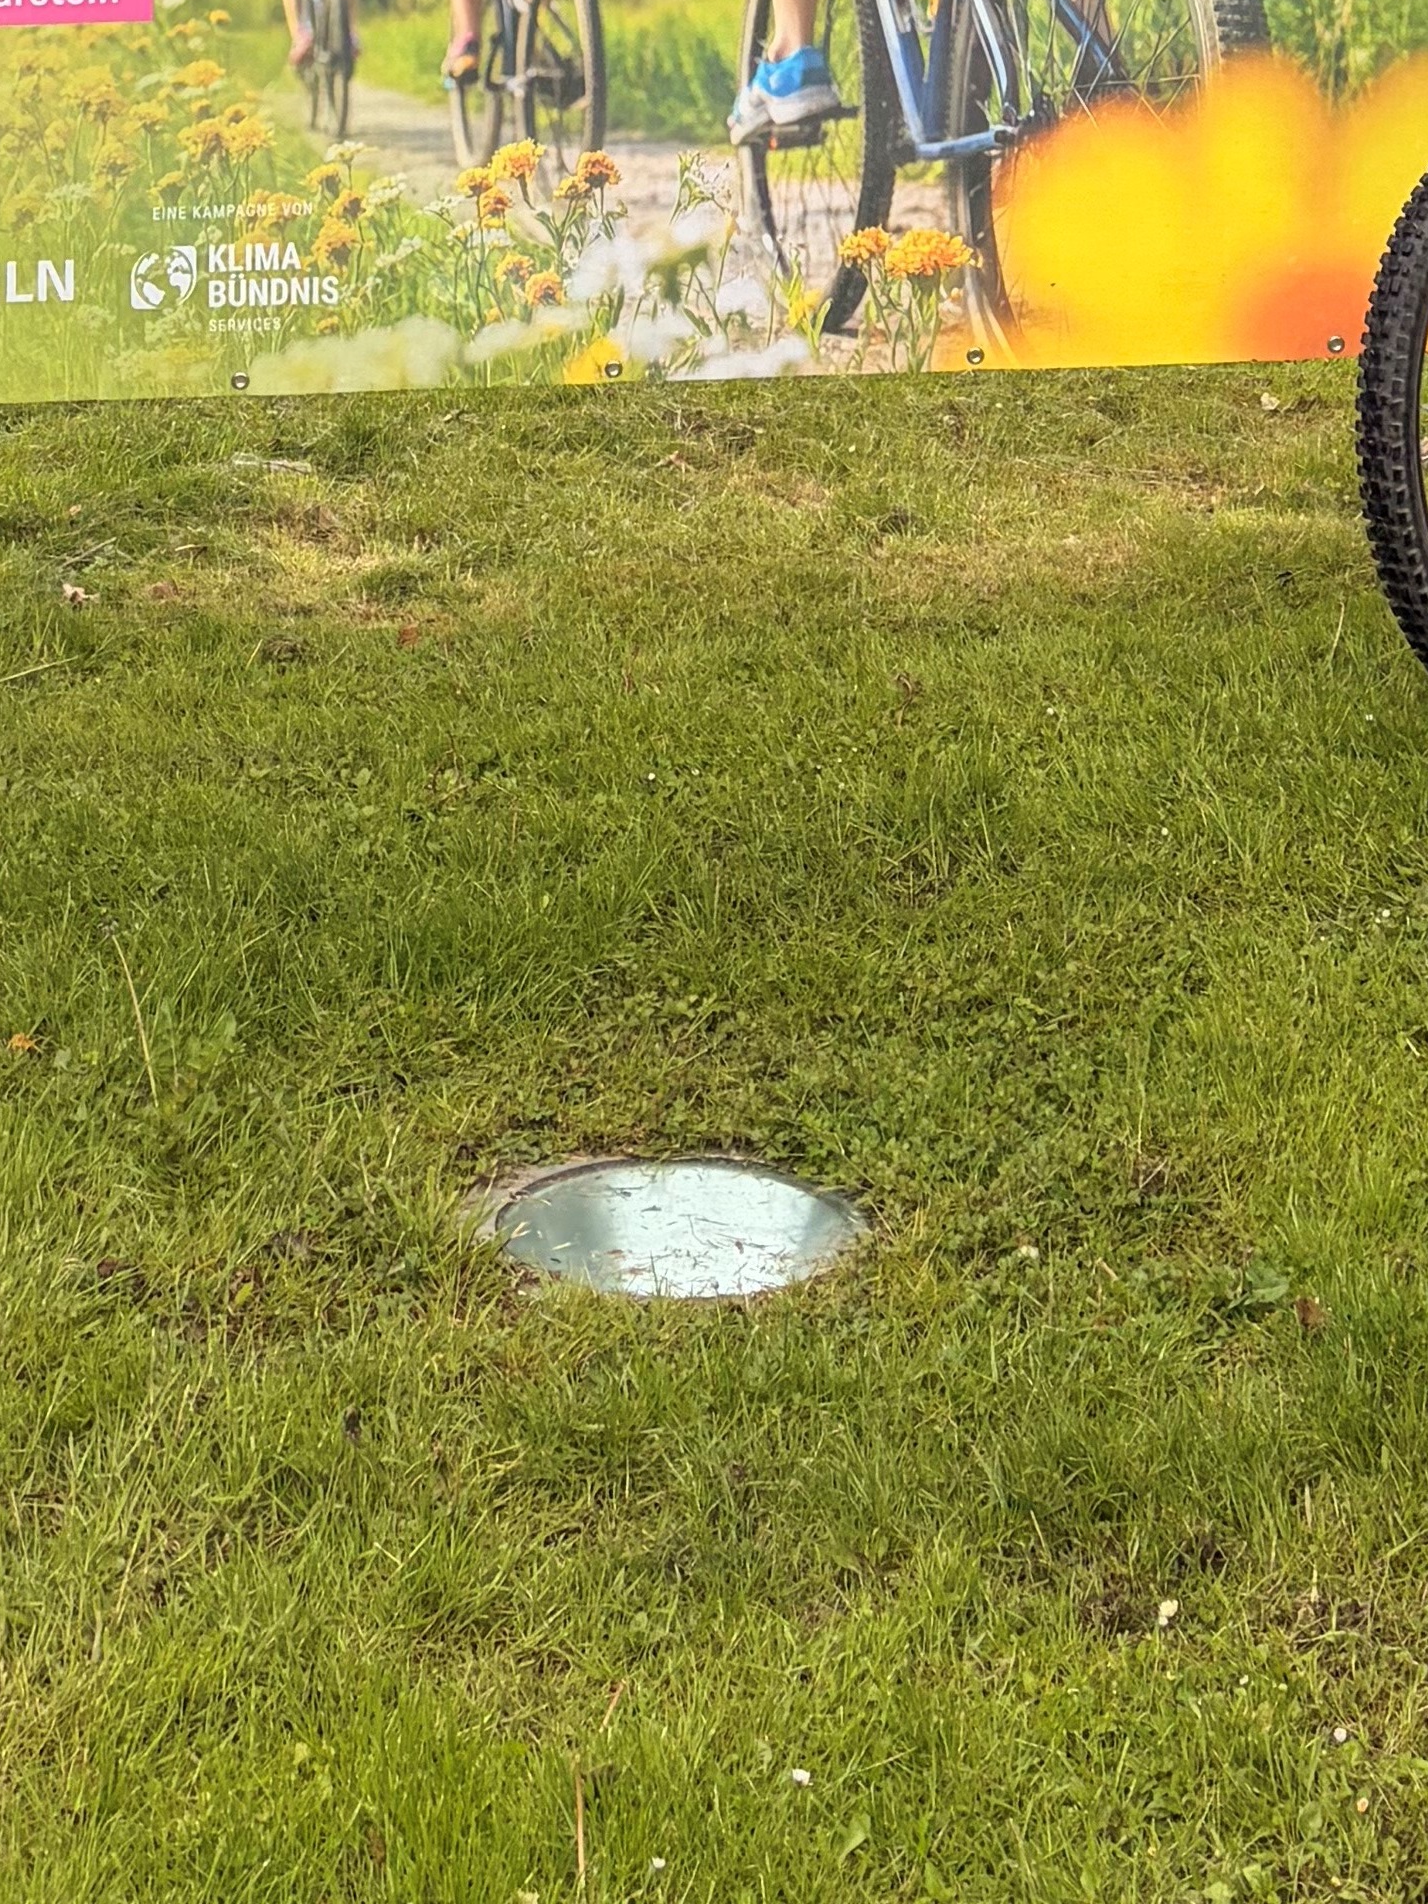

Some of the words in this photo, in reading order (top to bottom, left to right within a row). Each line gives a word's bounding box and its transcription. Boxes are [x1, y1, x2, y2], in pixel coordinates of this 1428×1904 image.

[152, 206, 187, 221] EINE
[192, 203, 279, 219] KAMPAGNE
[281, 201, 314, 217] VON
[207, 242, 302, 273] KLIMA
[207, 273, 340, 309] BÜNDNIS
[208, 317, 282, 333] SERVICES
